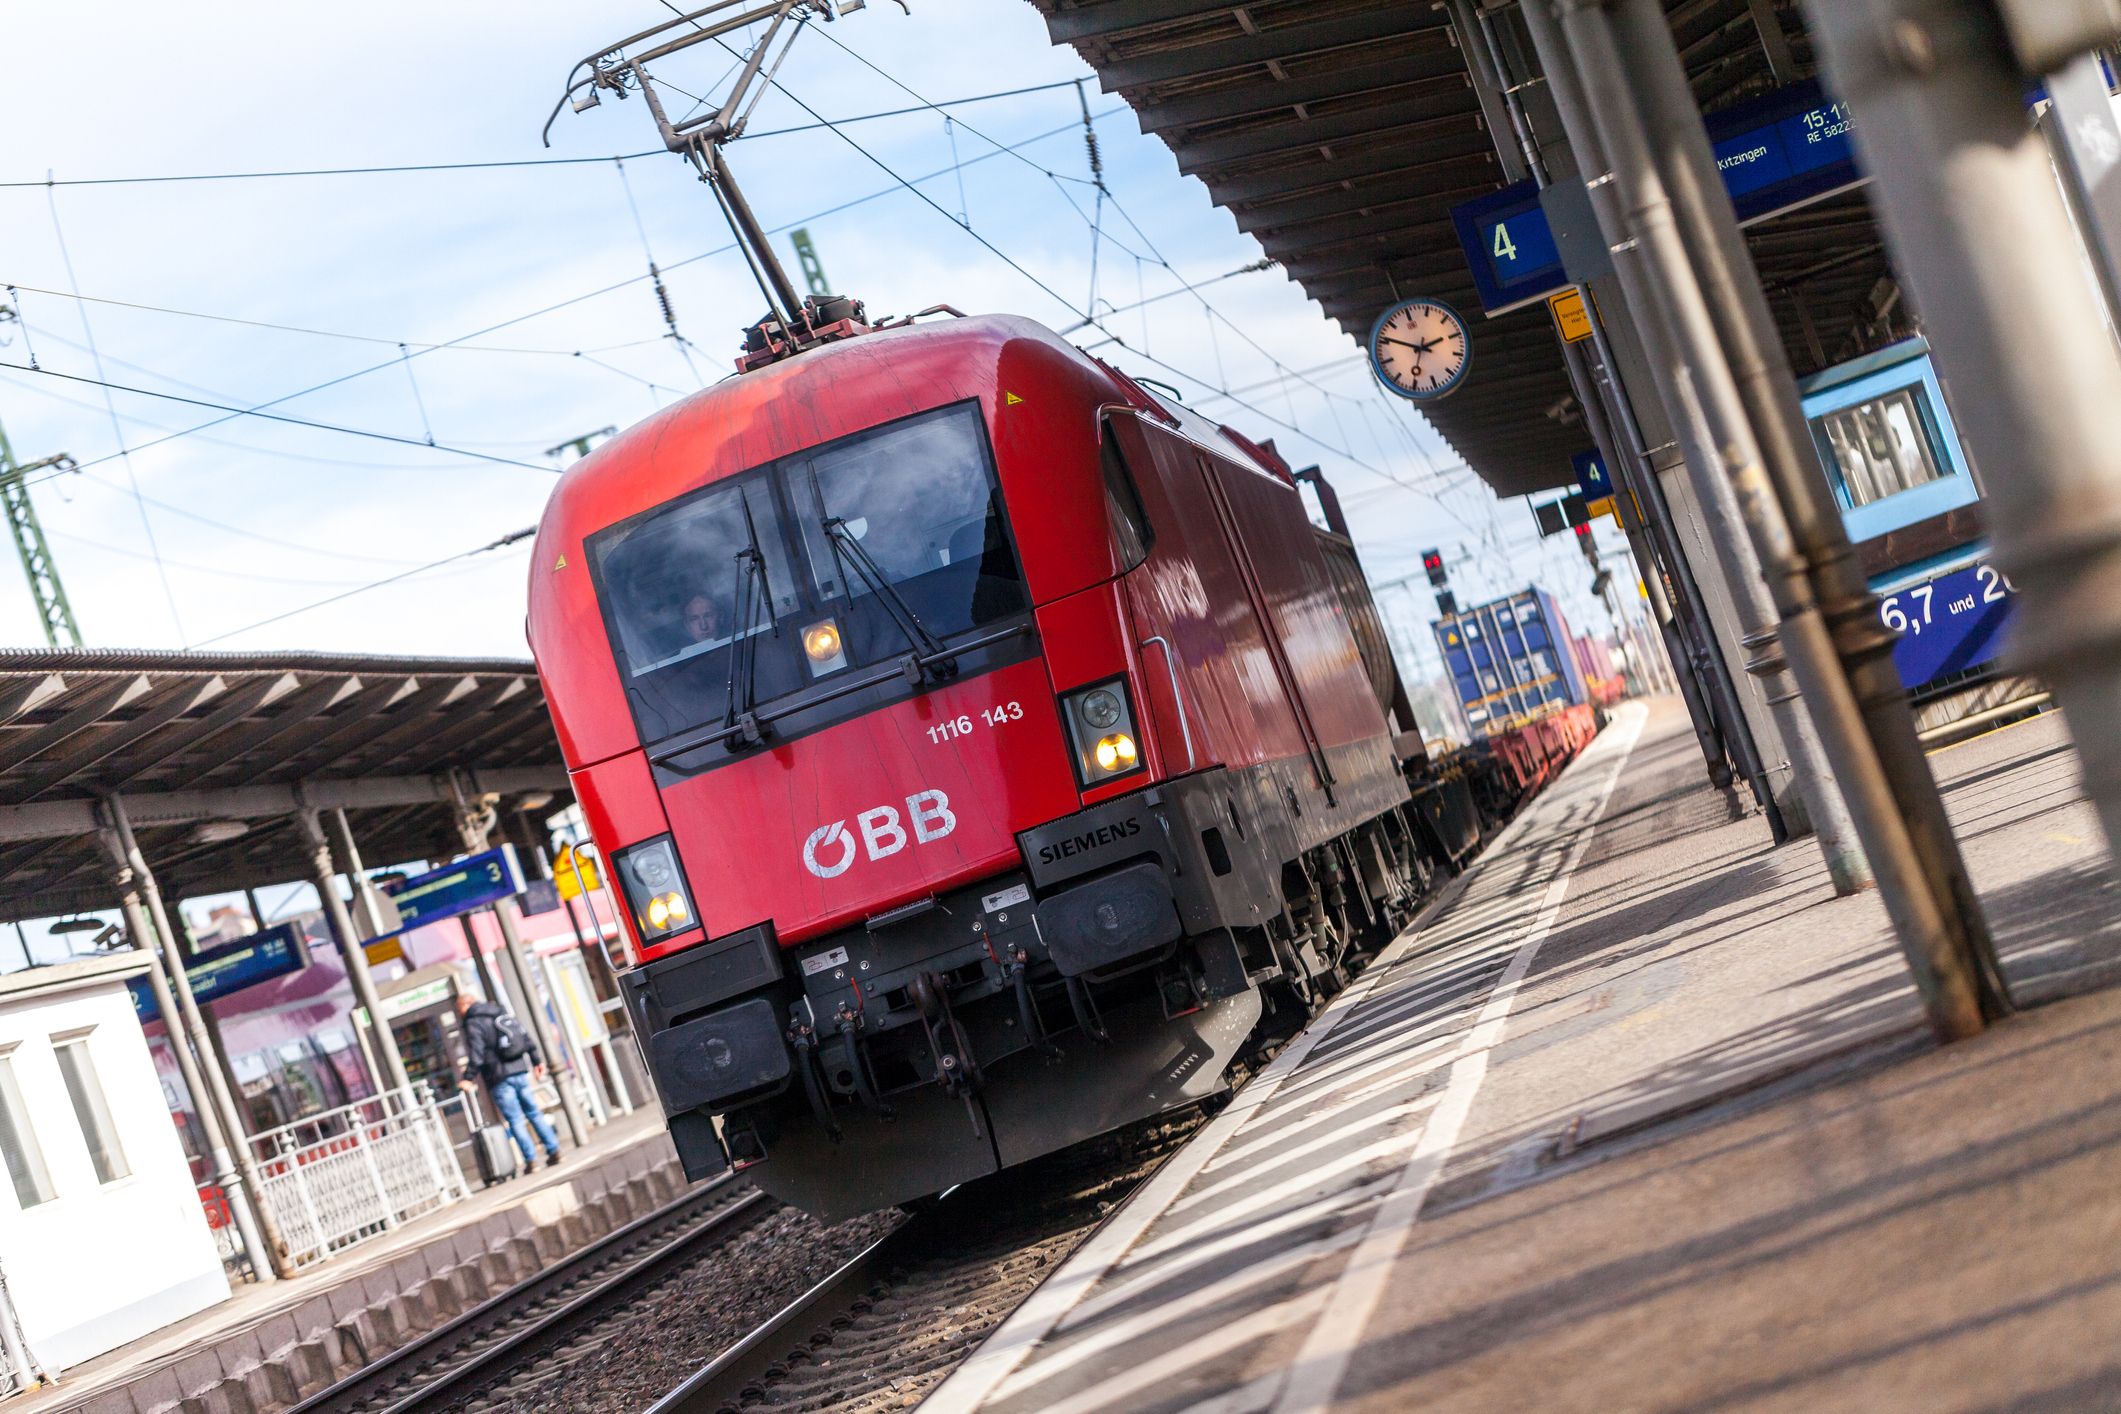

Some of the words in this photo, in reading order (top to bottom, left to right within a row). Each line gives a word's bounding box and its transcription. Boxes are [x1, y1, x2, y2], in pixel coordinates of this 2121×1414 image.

[1807, 131, 1822, 144] RE
[1717, 146, 1767, 170] Kitzingen
[1494, 223, 1517, 261] 4
[1589, 462, 1601, 482] 4
[1880, 585, 1933, 636] 6,7
[1949, 594, 1976, 615] und
[926, 715, 974, 744] 1116
[981, 701, 1024, 727] 143
[803, 789, 957, 878] ÖBB
[1038, 817, 1141, 865] SIEMENS
[486, 862, 502, 883] 3
